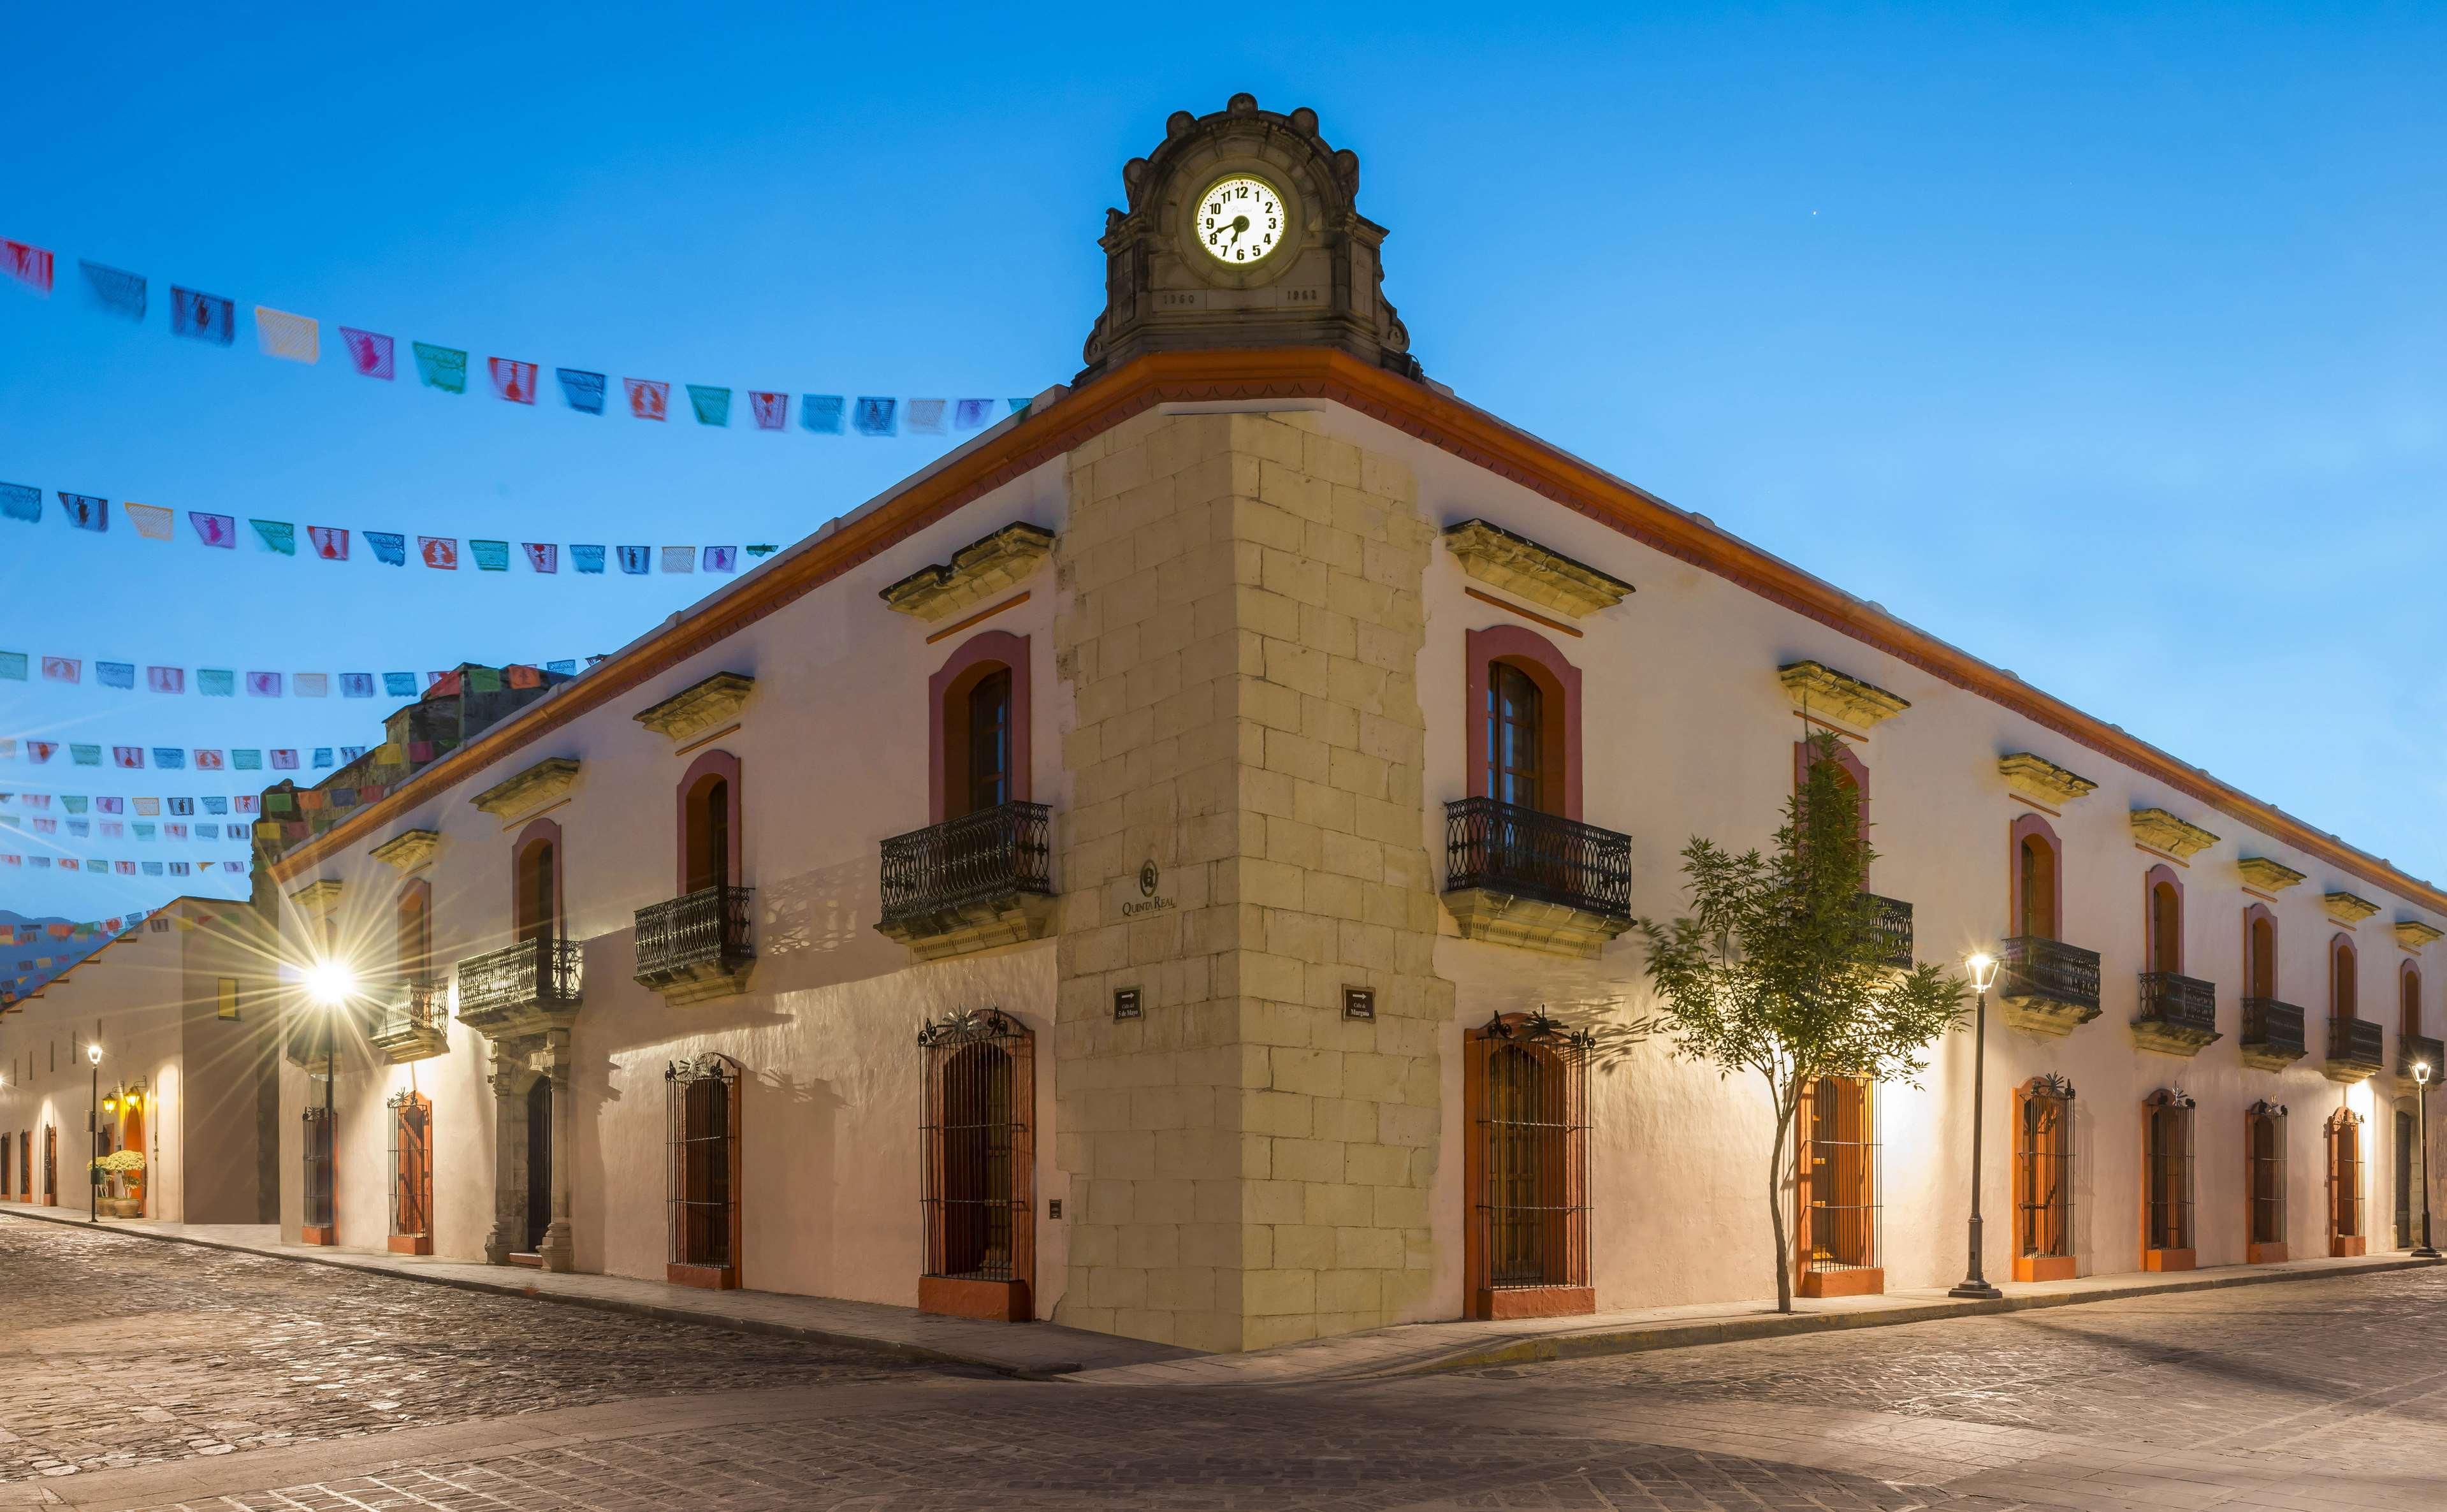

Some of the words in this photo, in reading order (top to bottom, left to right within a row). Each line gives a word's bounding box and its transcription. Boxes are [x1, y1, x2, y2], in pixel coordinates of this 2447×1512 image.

[1221, 191, 1231, 204] 11
[1235, 186, 1249, 199] 12
[1255, 191, 1260, 202] 1
[1209, 203, 1221, 215] 10
[1265, 201, 1274, 214] 2
[1206, 217, 1214, 229] 9
[1268, 217, 1277, 229] 3
[1209, 233, 1217, 245] 8
[1263, 233, 1272, 245] 4
[1221, 245, 1228, 257] 7
[1236, 249, 1245, 261] 6
[1253, 245, 1261, 256] 5
[1122, 901, 1153, 917] QUINTA
[1154, 896, 1177, 911] REAL
